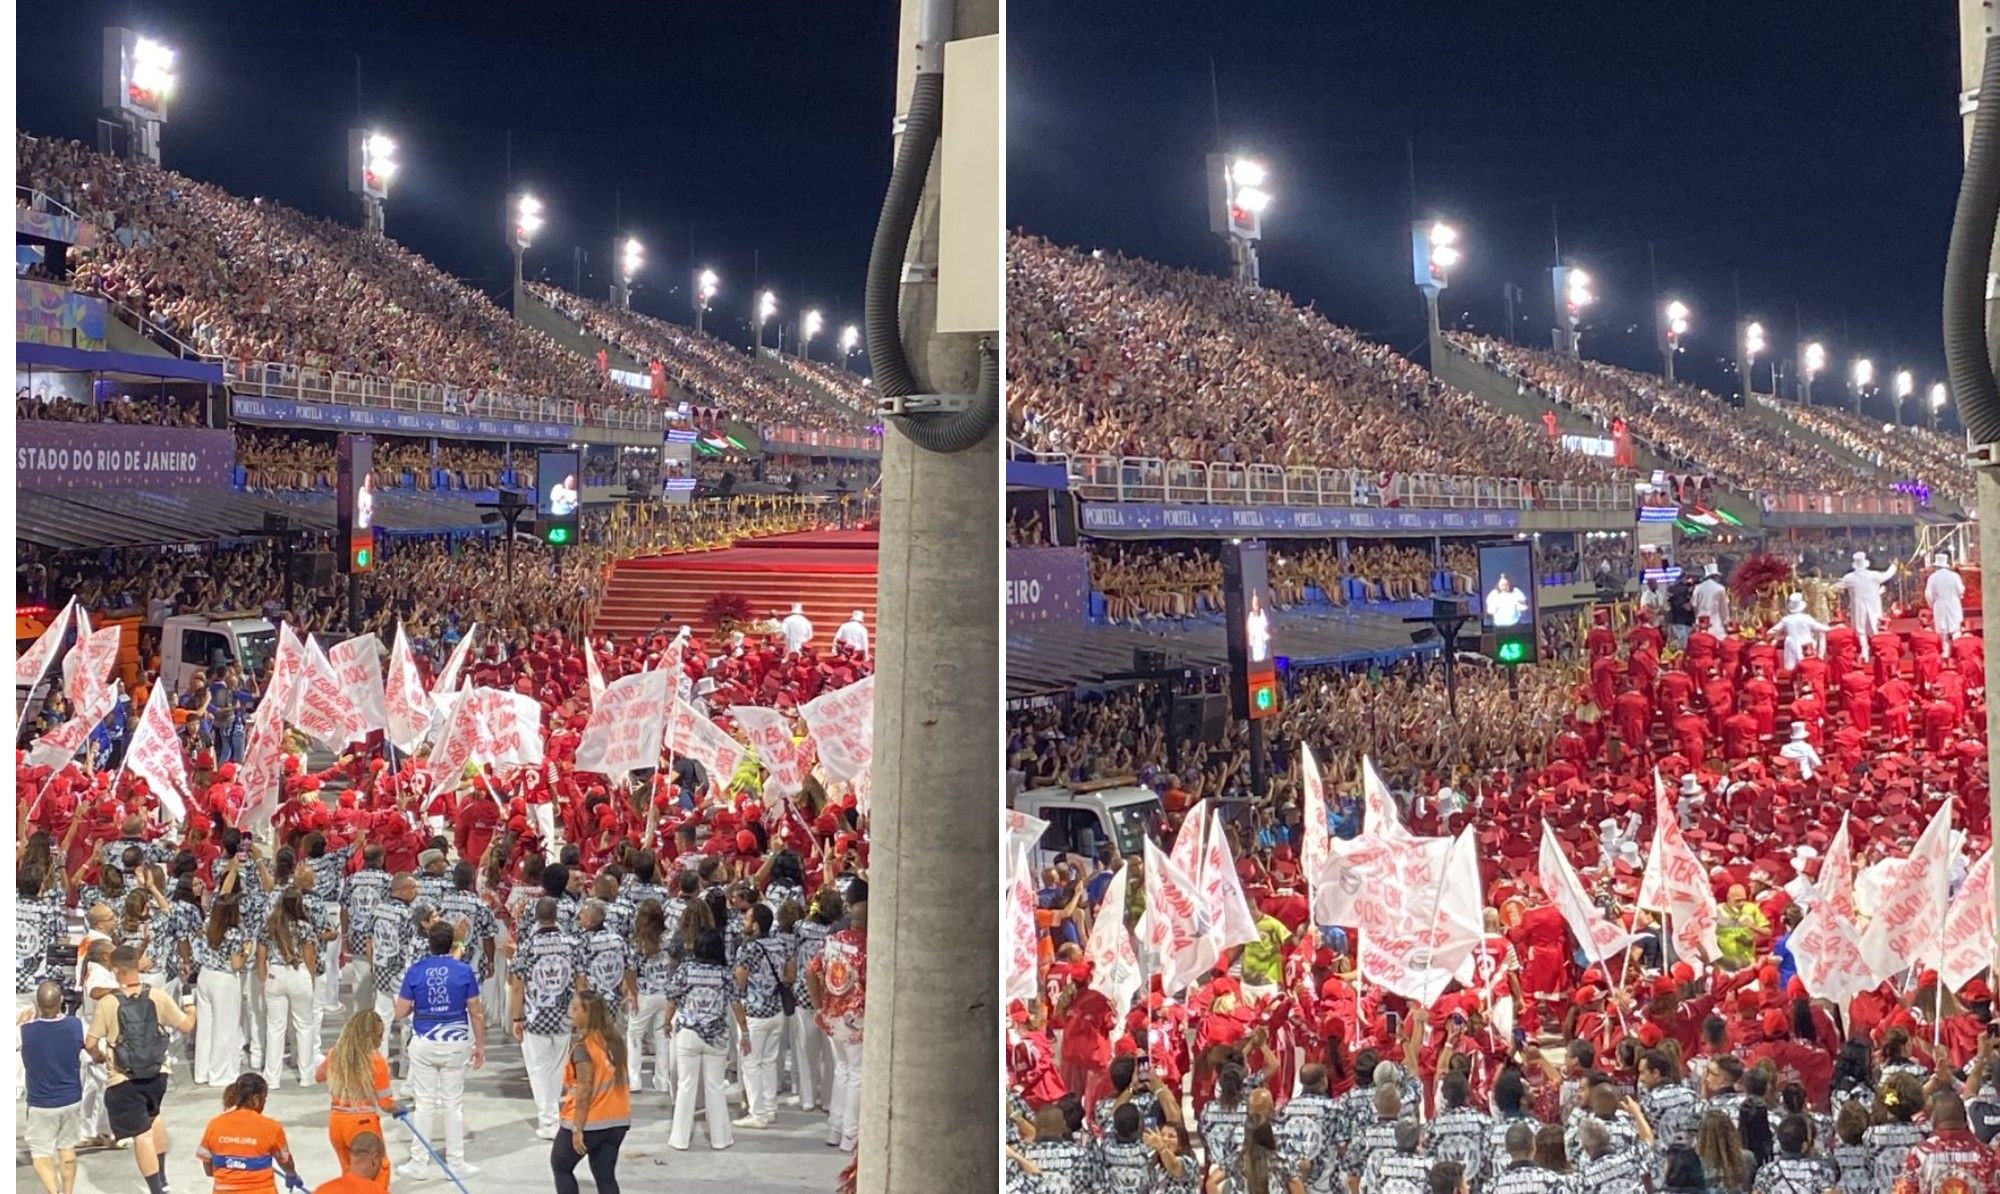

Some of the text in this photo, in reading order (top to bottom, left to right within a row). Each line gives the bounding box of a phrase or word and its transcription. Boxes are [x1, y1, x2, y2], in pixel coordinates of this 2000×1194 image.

[16, 447, 197, 472] STADO DO RIO DE JANEIRO
[1085, 508, 1125, 526] PORTELA
[1163, 509, 1199, 526] PORTELA
[1232, 510, 1265, 526] PORTELA
[218, 1135, 259, 1147] COMLURB
